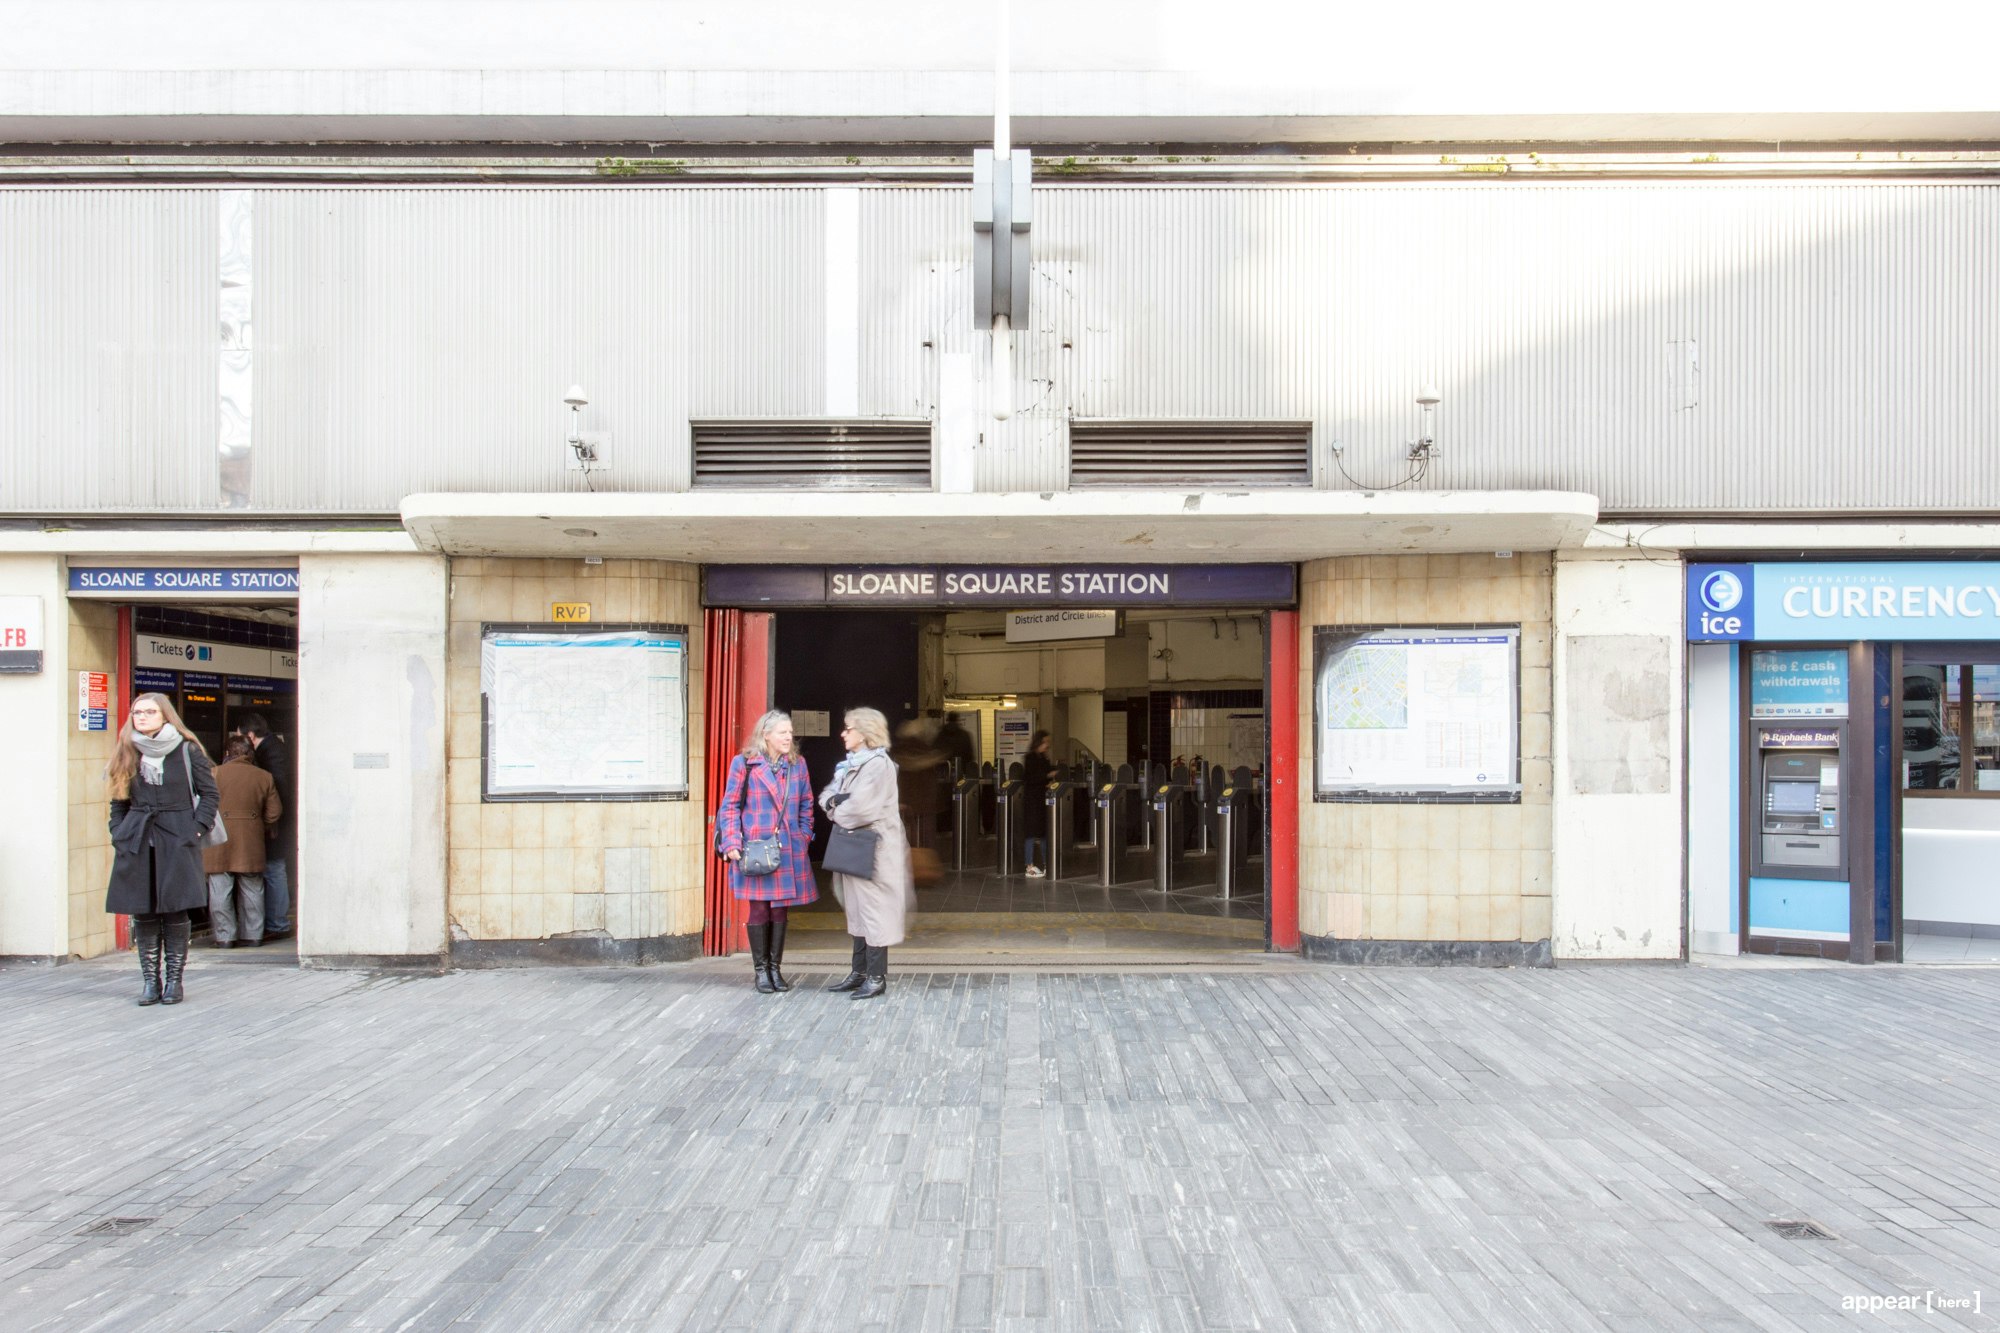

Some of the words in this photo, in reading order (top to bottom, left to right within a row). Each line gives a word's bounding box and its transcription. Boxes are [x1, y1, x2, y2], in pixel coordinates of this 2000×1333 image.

[80, 573, 146, 587] SLOANE
[154, 573, 222, 587] SQUARE
[231, 573, 299, 587] STATION
[832, 573, 934, 594] SLOANE
[945, 573, 1051, 594] SQUARE
[1061, 573, 1169, 594] STATION
[1783, 586, 2000, 618] CURRENCY
[556, 606, 587, 619] RVP
[1015, 615, 1043, 625] District
[1045, 613, 1059, 622] and
[1061, 611, 1085, 621] Circle
[1087, 611, 1107, 619] lines
[1700, 611, 1741, 634] ice
[0, 627, 26, 647] FB
[151, 641, 184, 656] Tickets
[1762, 662, 1787, 672] free
[1790, 661, 1799, 672] £
[1803, 660, 1836, 671] cash
[1760, 675, 1840, 687] withdrawals
[1772, 733, 1812, 743] Raphaels
[1814, 733, 1837, 741] Bank
